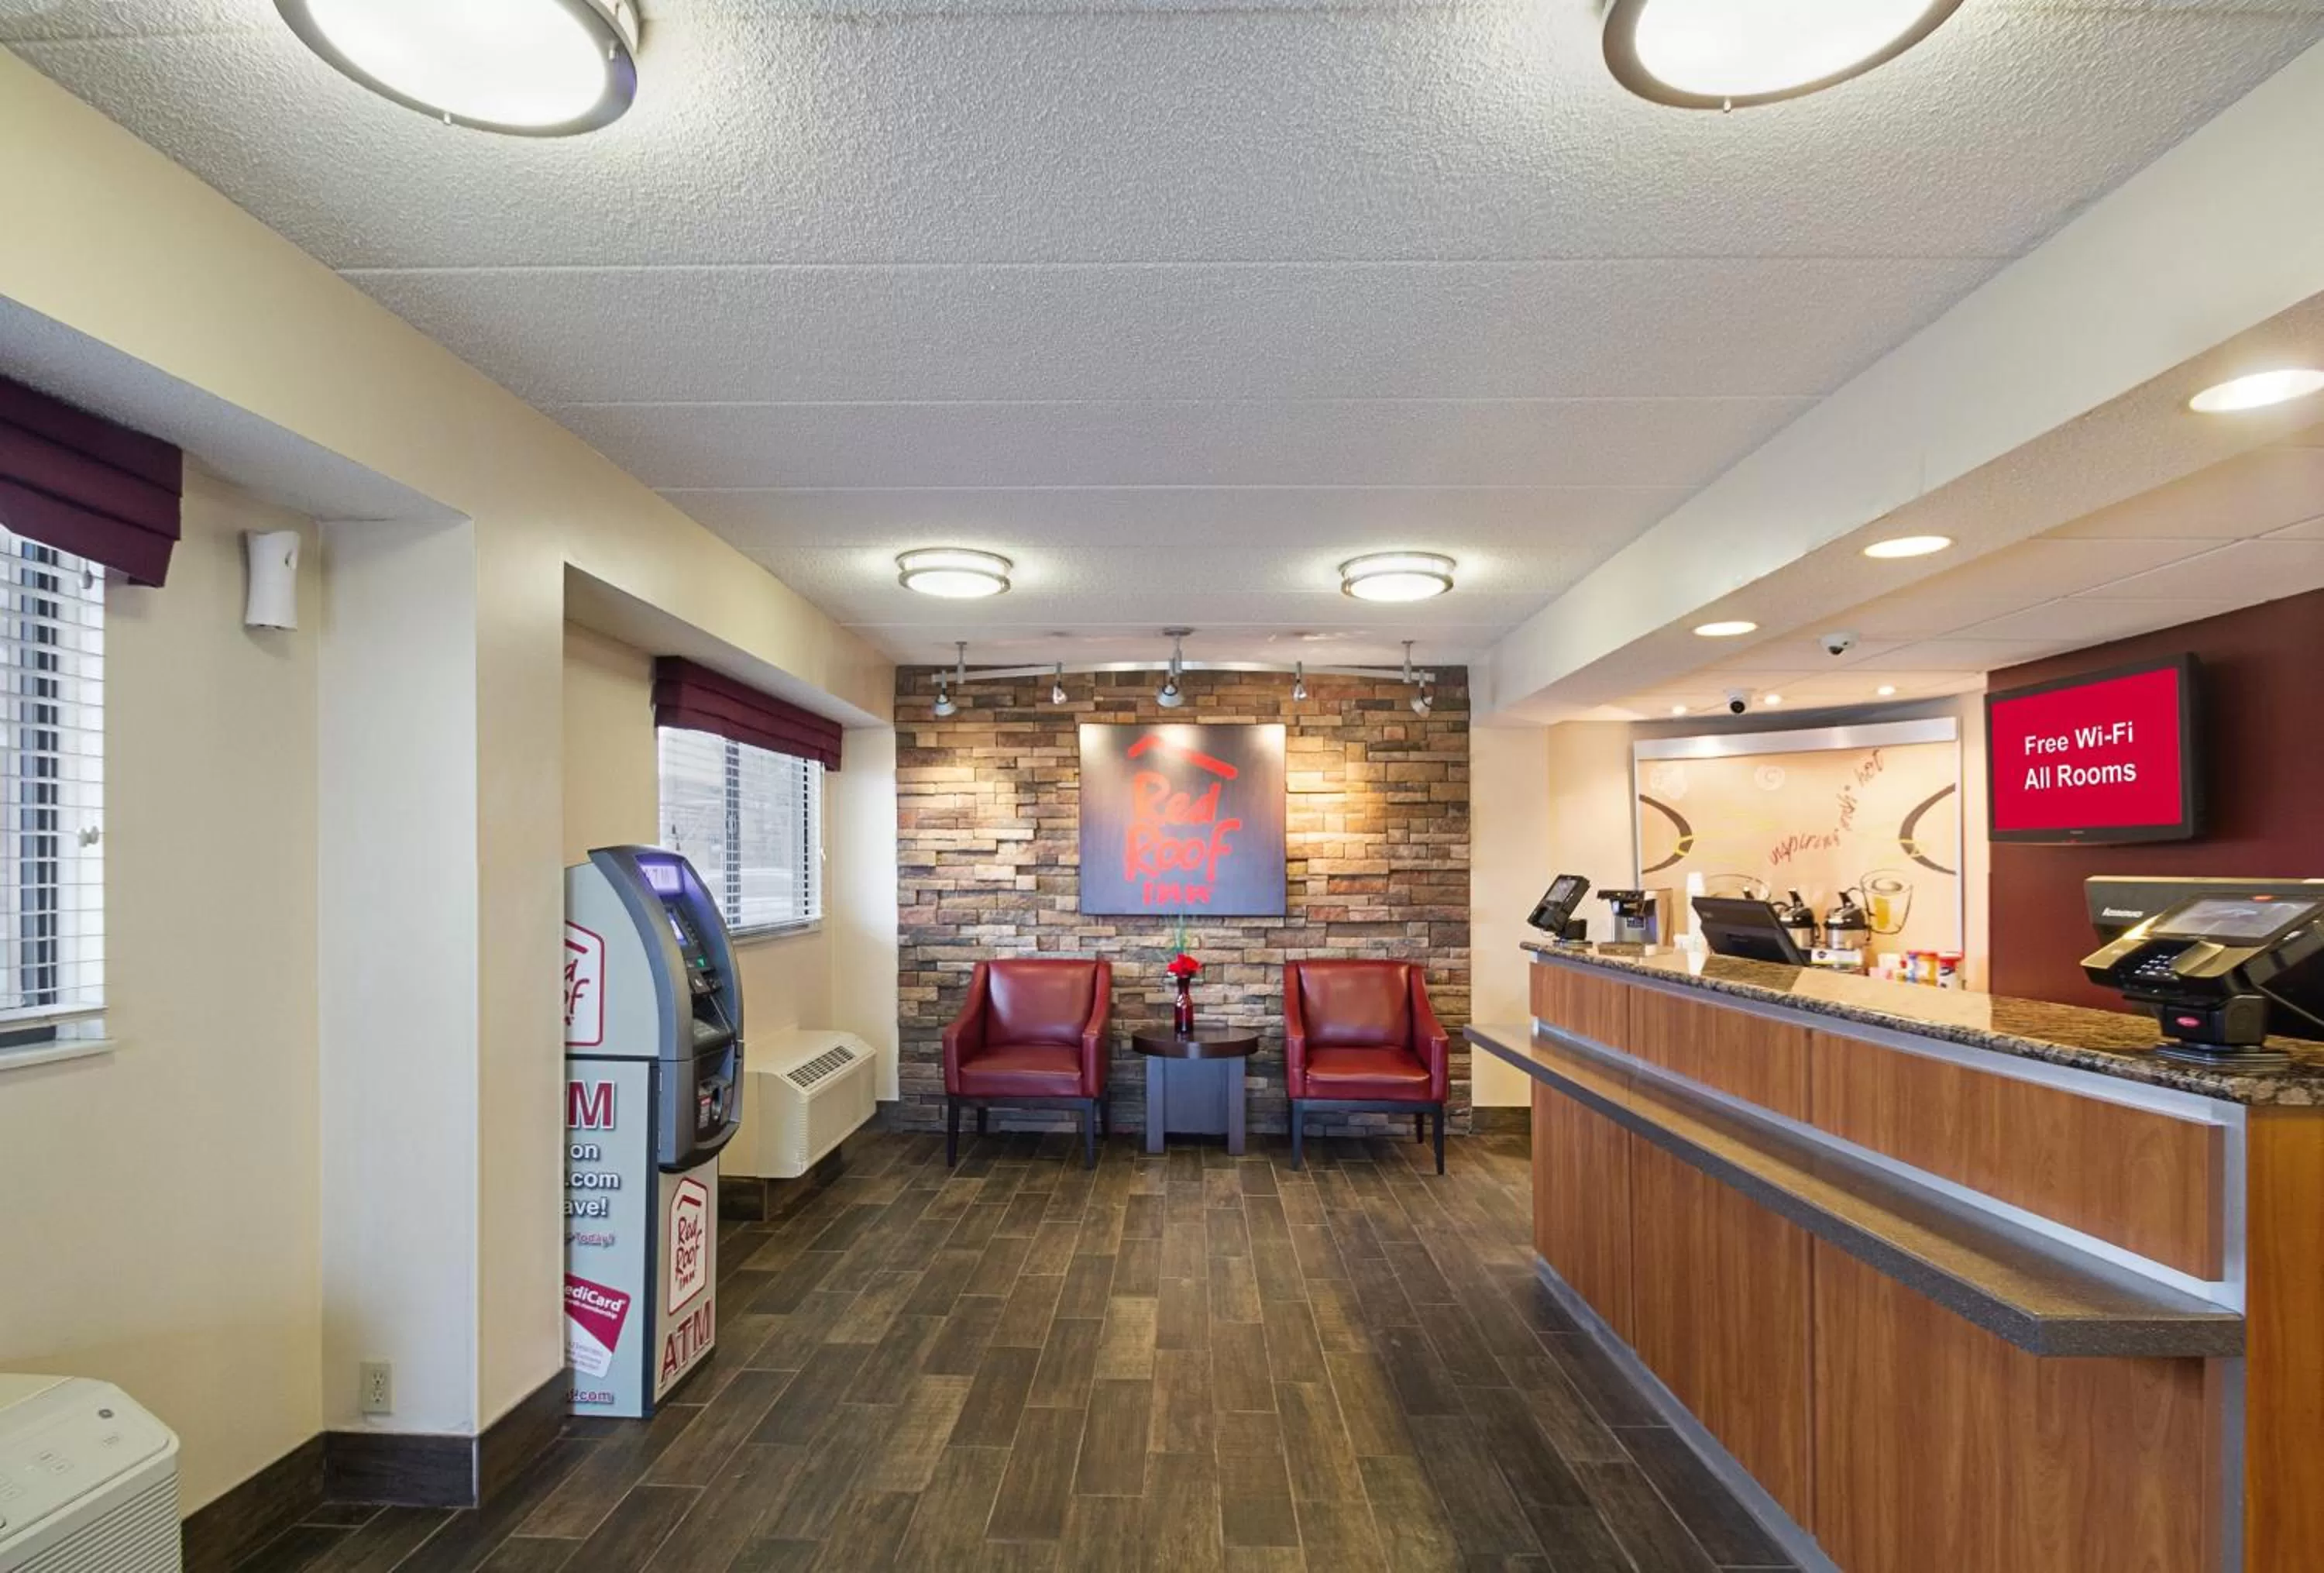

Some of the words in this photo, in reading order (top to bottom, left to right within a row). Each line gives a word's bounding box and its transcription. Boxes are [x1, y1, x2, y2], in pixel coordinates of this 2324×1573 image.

[2023, 734, 2069, 756] Free
[2075, 721, 2133, 749] Wi-Fi
[2023, 766, 2051, 790] All
[2057, 762, 2137, 787] Rooms
[1132, 770, 1222, 824] Red
[1124, 818, 1242, 882] Roof
[570, 1144, 599, 1160] on
[565, 1172, 620, 1189] .com
[659, 1298, 713, 1385] ATM
